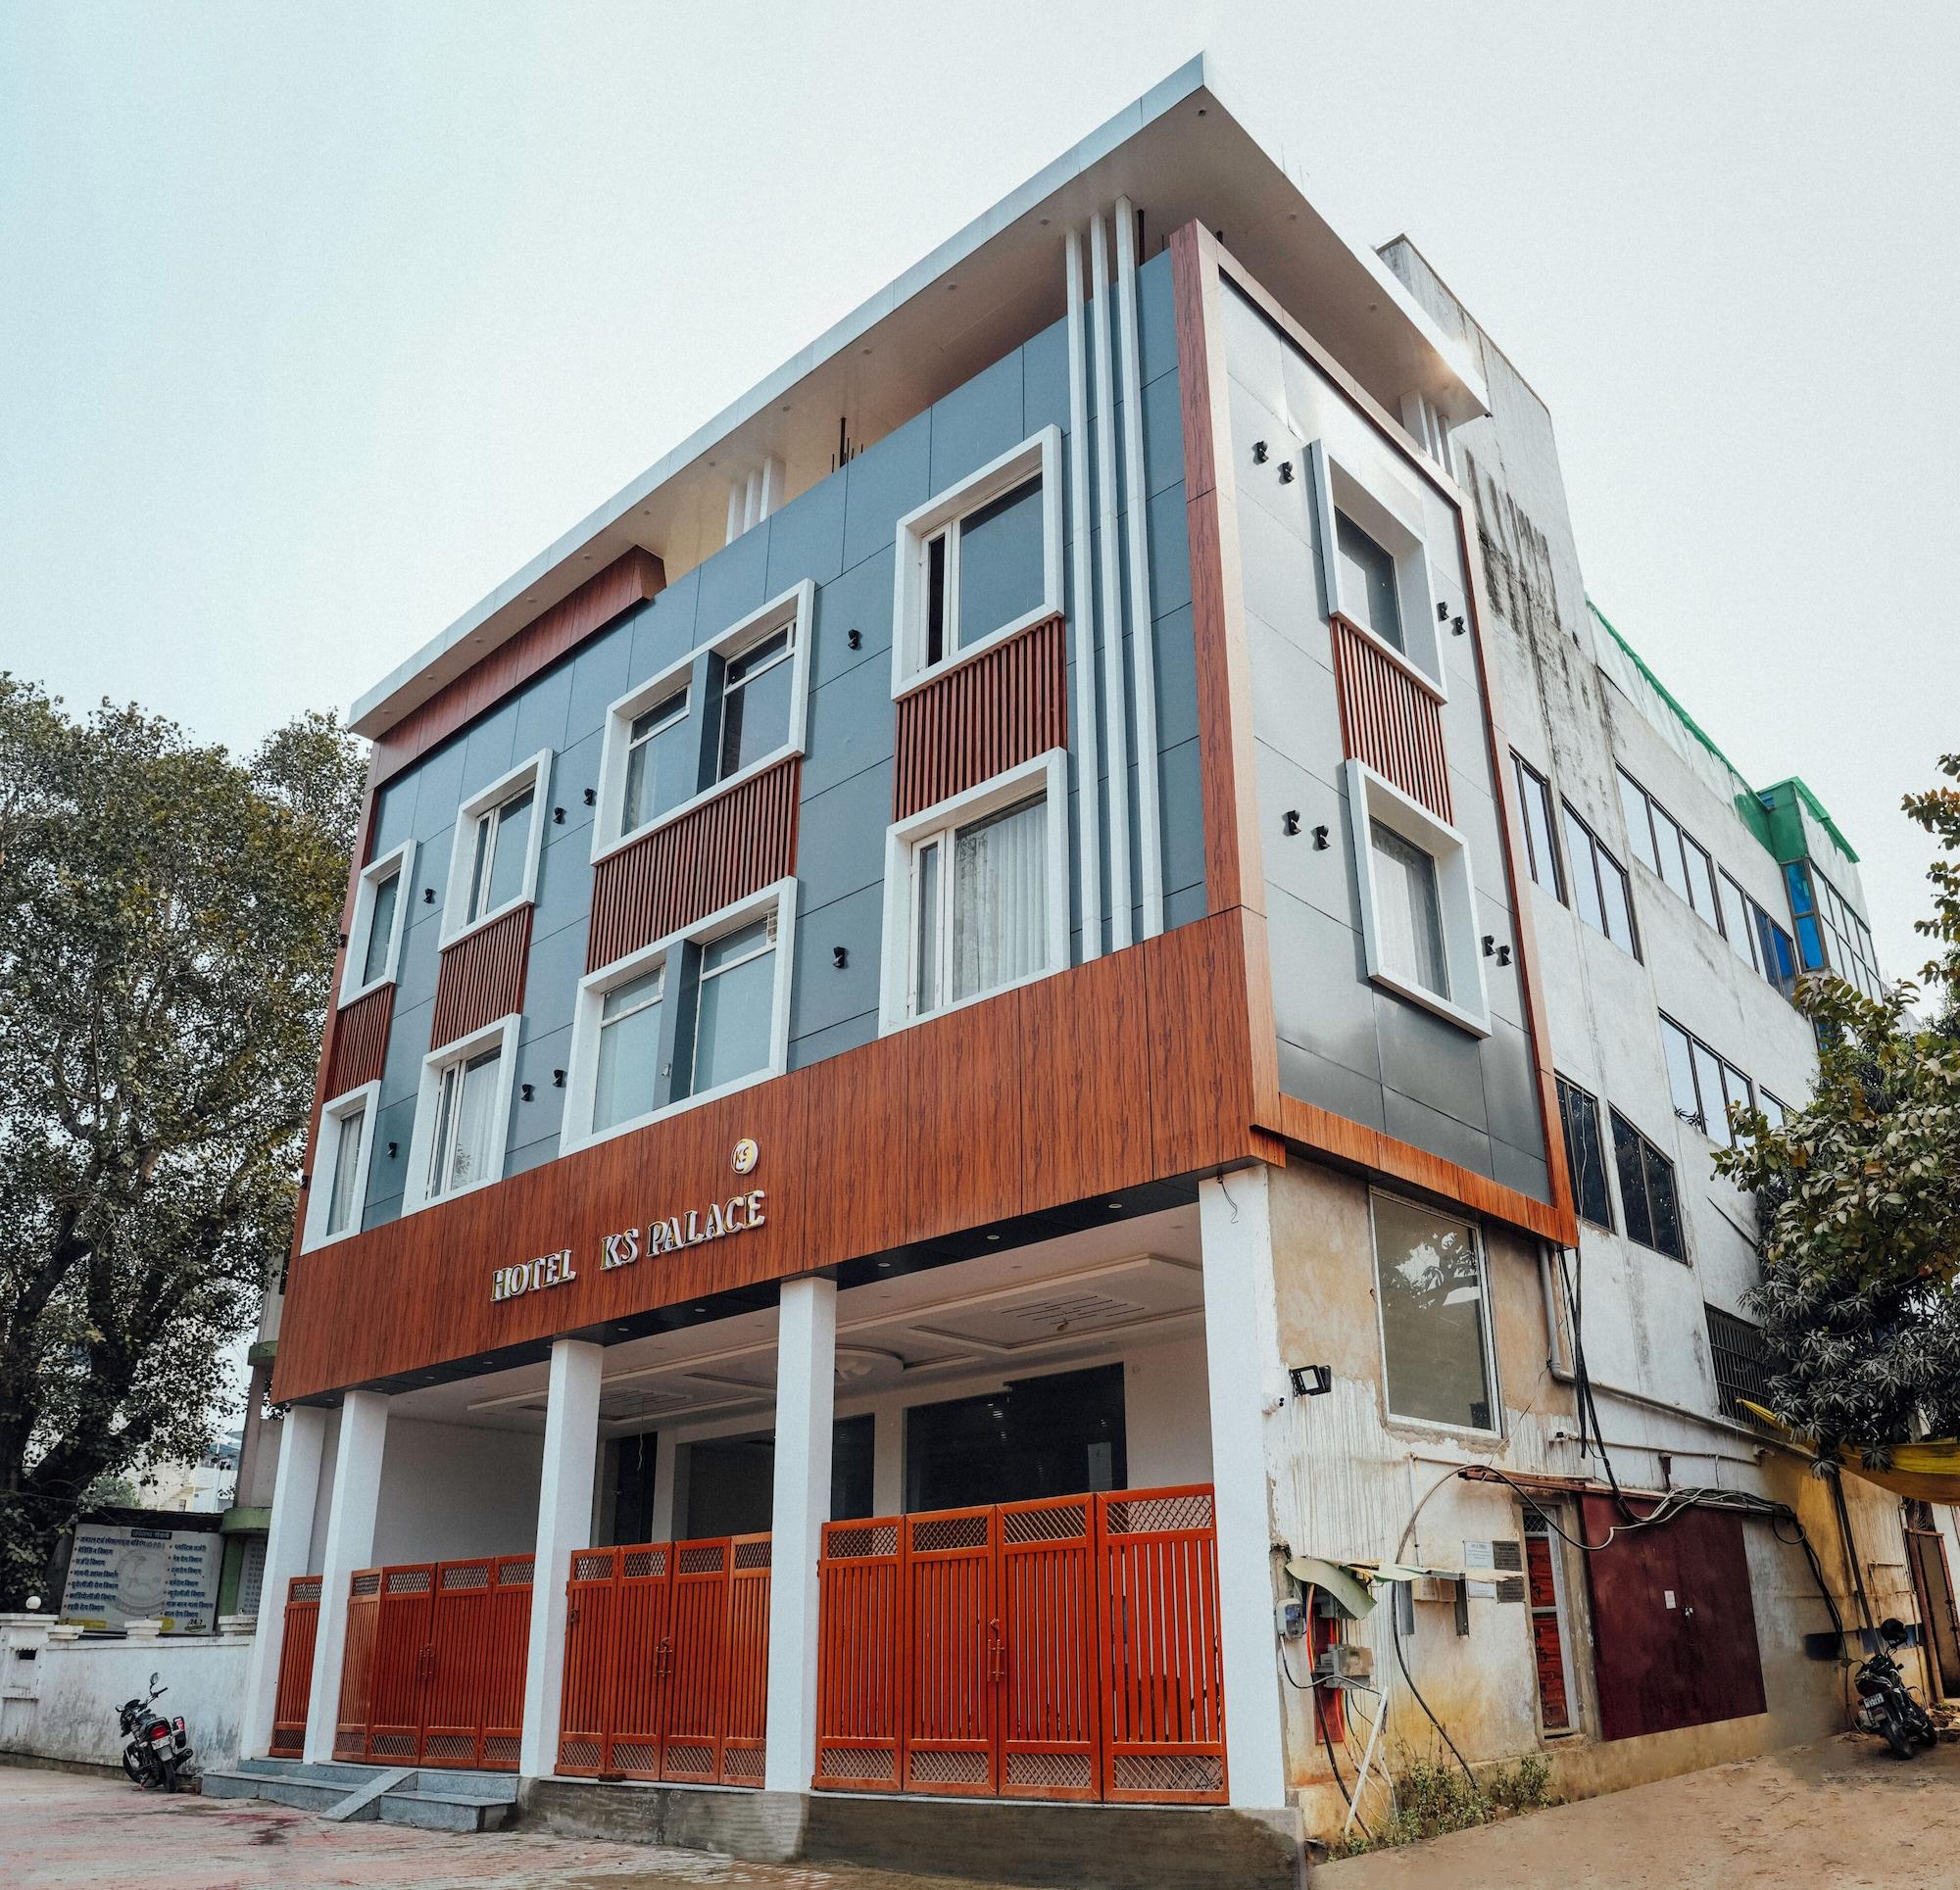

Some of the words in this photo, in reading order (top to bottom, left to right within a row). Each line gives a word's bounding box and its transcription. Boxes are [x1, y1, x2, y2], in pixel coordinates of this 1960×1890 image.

[490, 1249, 576, 1302] HOTEL
[600, 1228, 639, 1271] KS
[646, 1189, 765, 1258] PALACE
